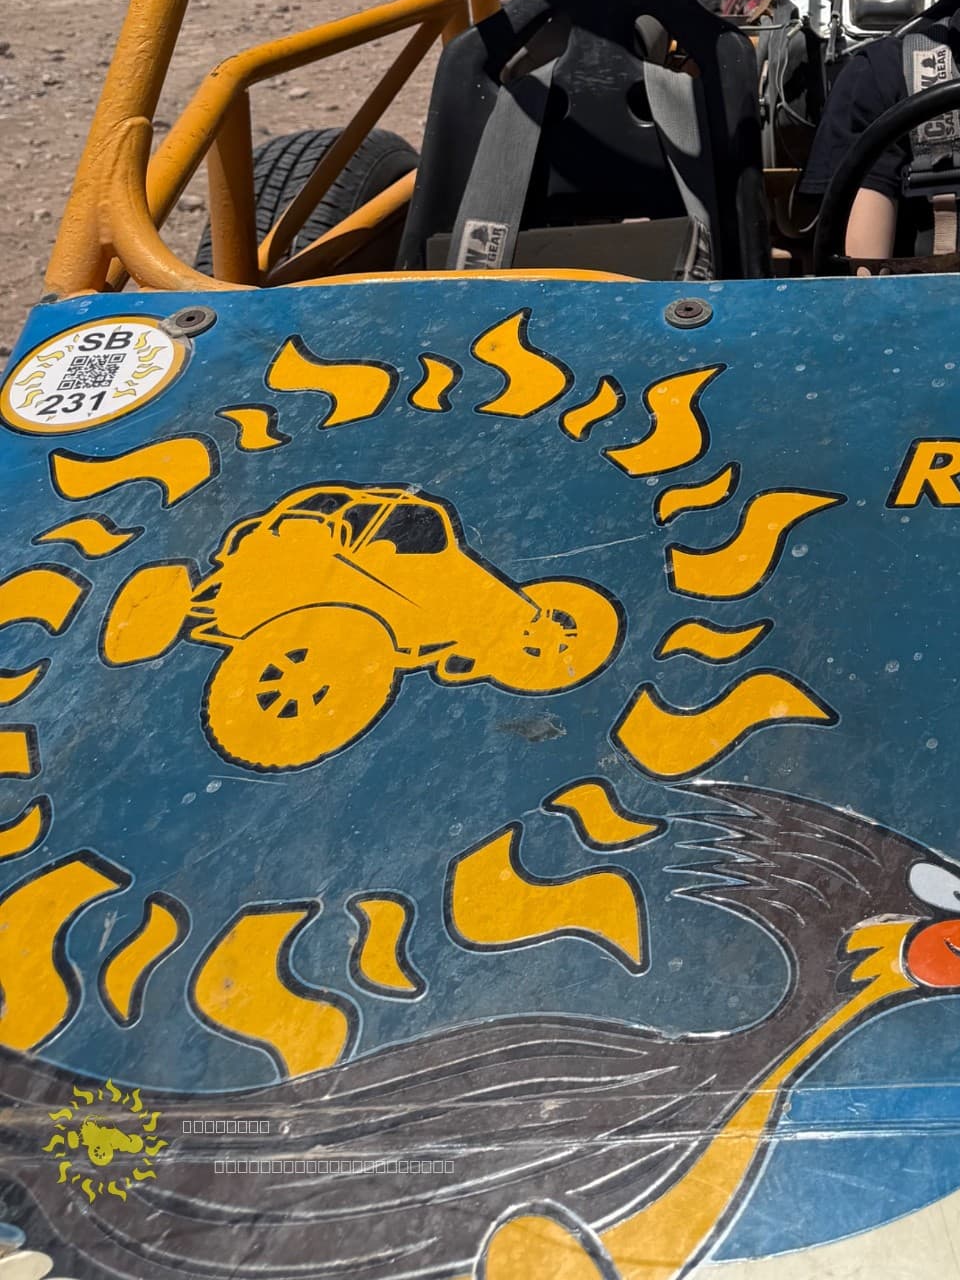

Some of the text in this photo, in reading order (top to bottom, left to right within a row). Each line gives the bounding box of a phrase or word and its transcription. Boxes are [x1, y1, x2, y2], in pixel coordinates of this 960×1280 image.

[936, 49, 948, 80] GEAR
[487, 227, 504, 262] GEAR
[78, 331, 134, 352] SB
[37, 391, 108, 416] 231
